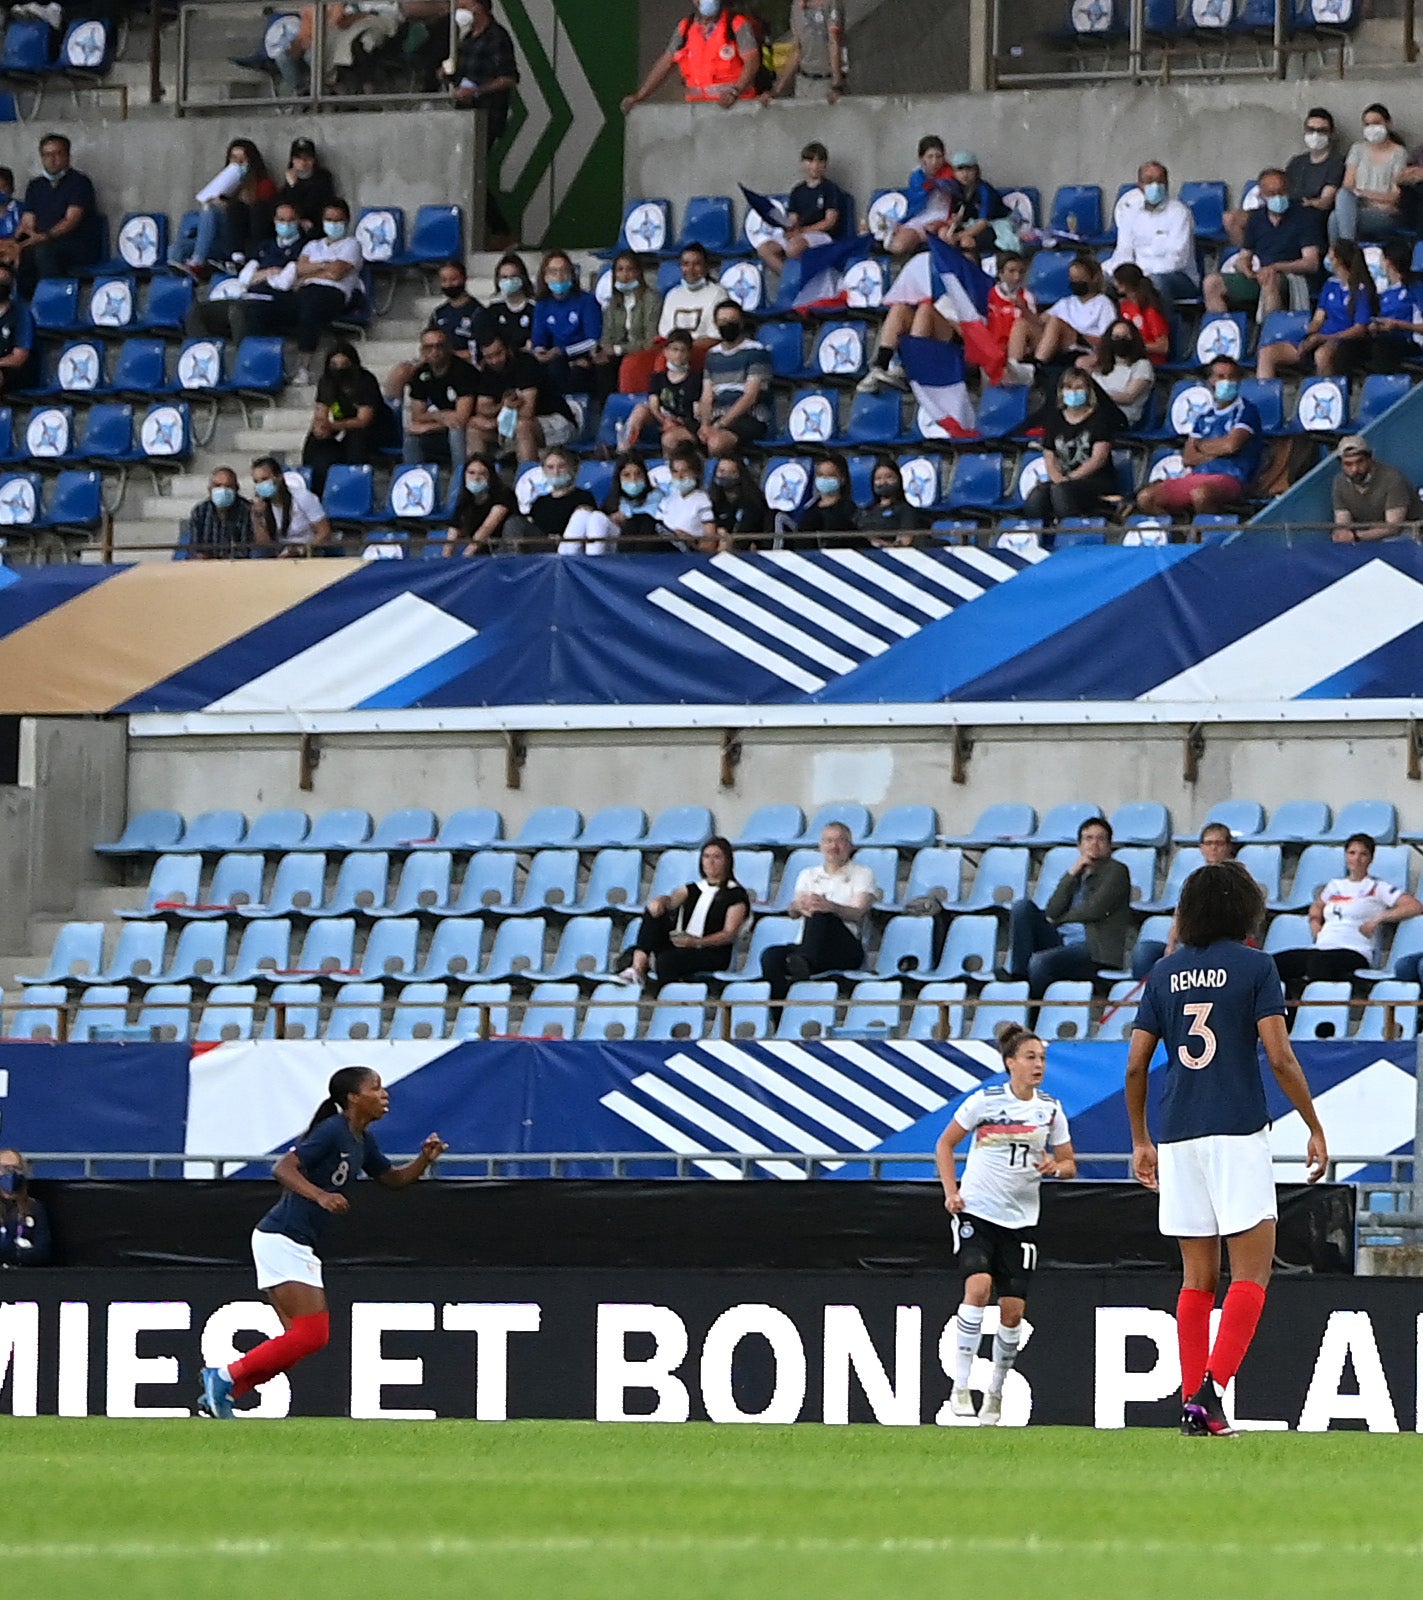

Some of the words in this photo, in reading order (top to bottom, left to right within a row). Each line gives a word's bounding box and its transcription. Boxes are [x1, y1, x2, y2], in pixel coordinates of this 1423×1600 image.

[1170, 968, 1227, 994] RENARD
[1177, 1002, 1217, 1070] 3
[331, 1160, 350, 1187] 8
[350, 1302, 542, 1421] ET
[596, 1303, 1033, 1427] BONS
